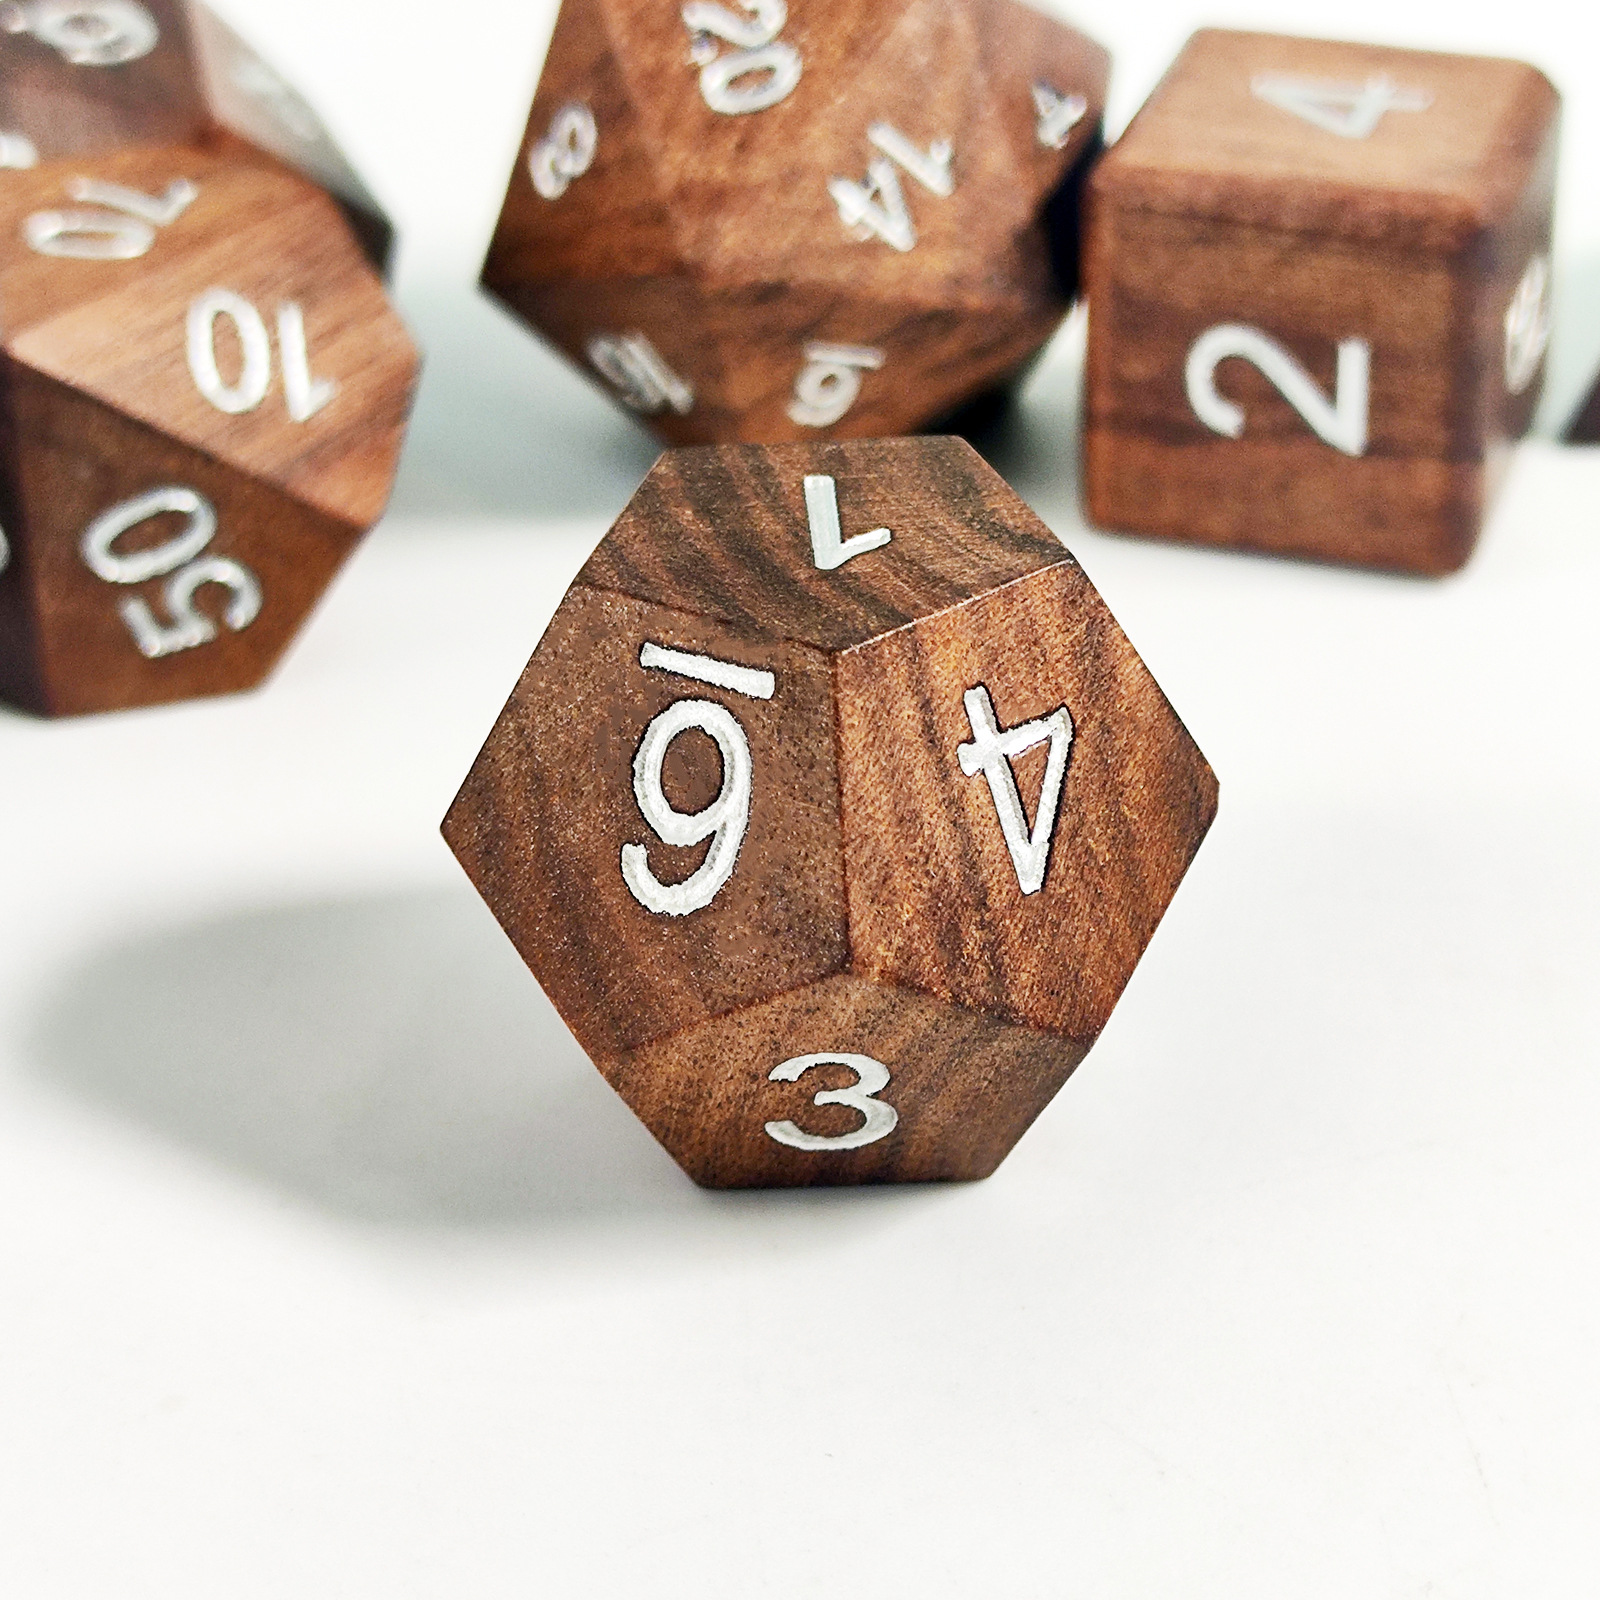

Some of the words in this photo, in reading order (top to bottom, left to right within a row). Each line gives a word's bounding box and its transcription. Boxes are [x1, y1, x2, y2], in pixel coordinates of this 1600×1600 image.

[682, 0, 803, 116] 20
[1251, 72, 1434, 139] 4
[528, 103, 598, 201] 8
[828, 121, 953, 251] 14
[23, 176, 198, 260] 70
[185, 286, 337, 423] 10
[1185, 322, 1370, 458] 2
[80, 485, 262, 659] 50
[803, 475, 892, 571] 1
[957, 685, 1074, 896] 4
[764, 1053, 899, 1151] 3
